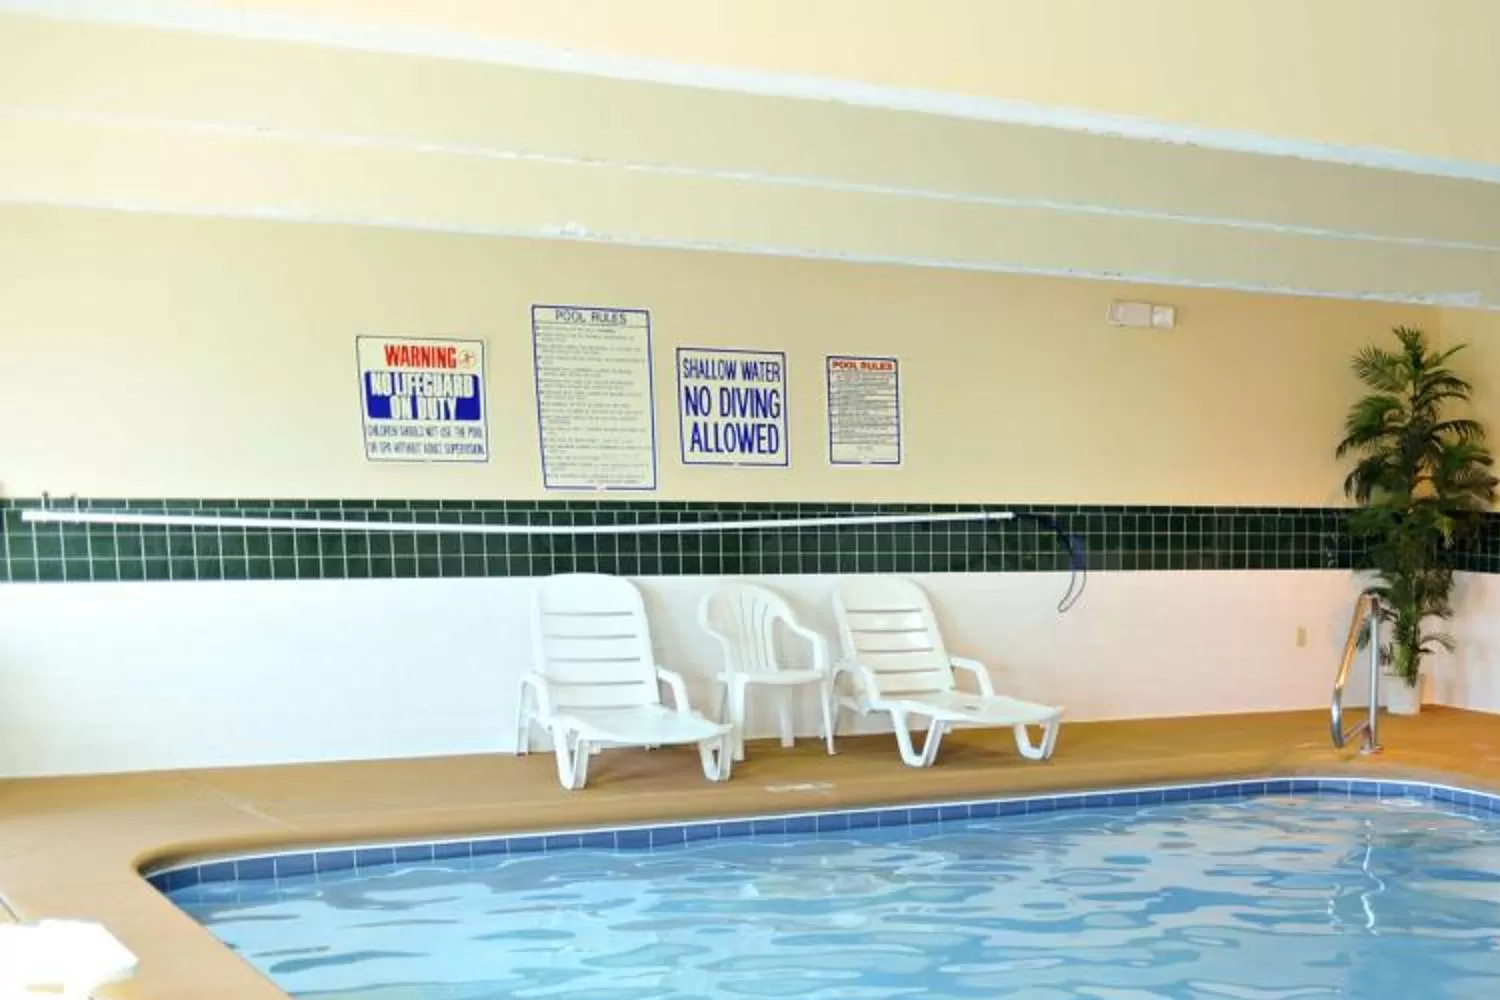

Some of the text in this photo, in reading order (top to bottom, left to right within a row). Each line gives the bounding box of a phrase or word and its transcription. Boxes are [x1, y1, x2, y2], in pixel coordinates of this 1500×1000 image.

[555, 309, 627, 325] POOL RULES
[384, 344, 457, 369] WARNING
[683, 358, 780, 382] SHALLOW WATER
[394, 372, 475, 398] LIFEGUARD
[389, 396, 457, 421] ON DUTY
[684, 386, 781, 419] NO DIVING
[690, 422, 780, 454] ALLOWED
